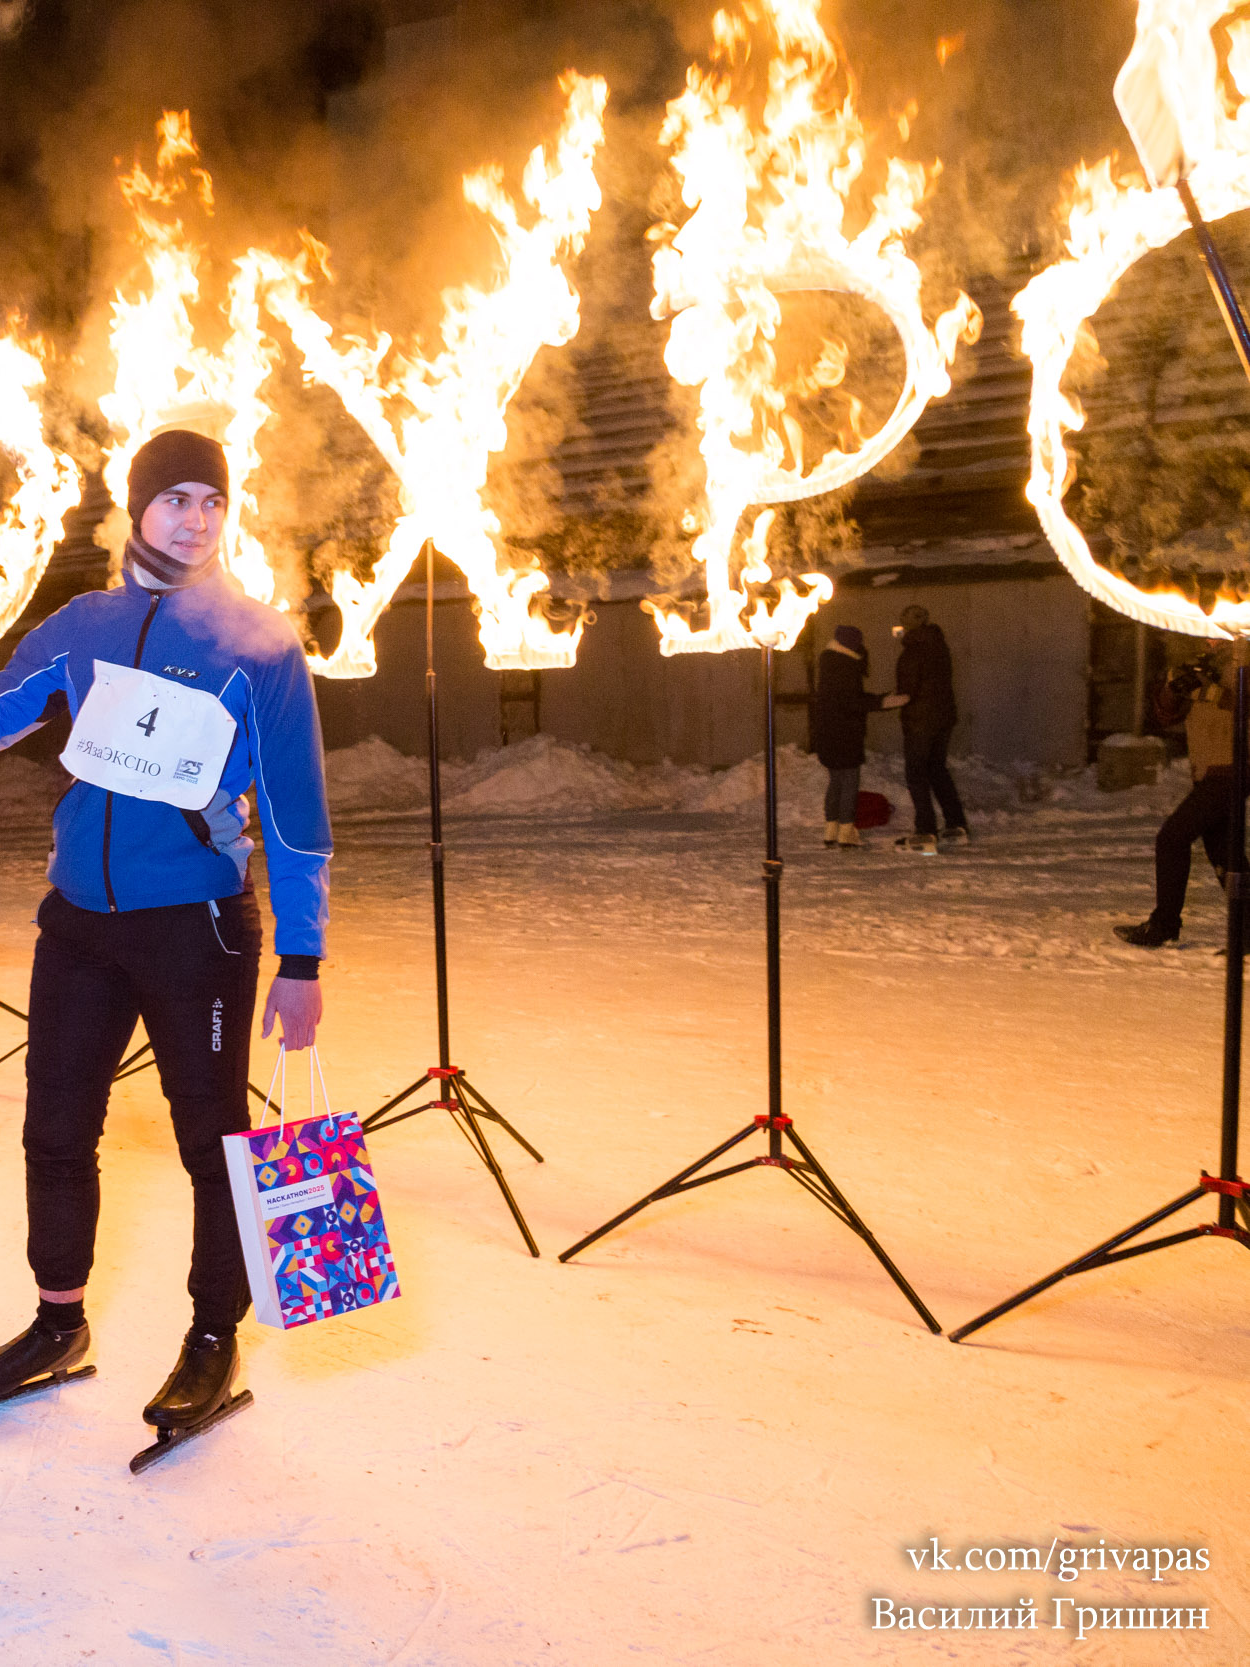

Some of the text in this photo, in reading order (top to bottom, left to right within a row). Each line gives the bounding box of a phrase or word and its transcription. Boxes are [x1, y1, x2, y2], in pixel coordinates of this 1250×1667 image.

[136, 706, 160, 738] 4
[77, 738, 161, 777] #ЯзаЭКСПО
[212, 1009, 222, 1052] CRAFT
[266, 1185, 325, 1205] HACKATHON2025
